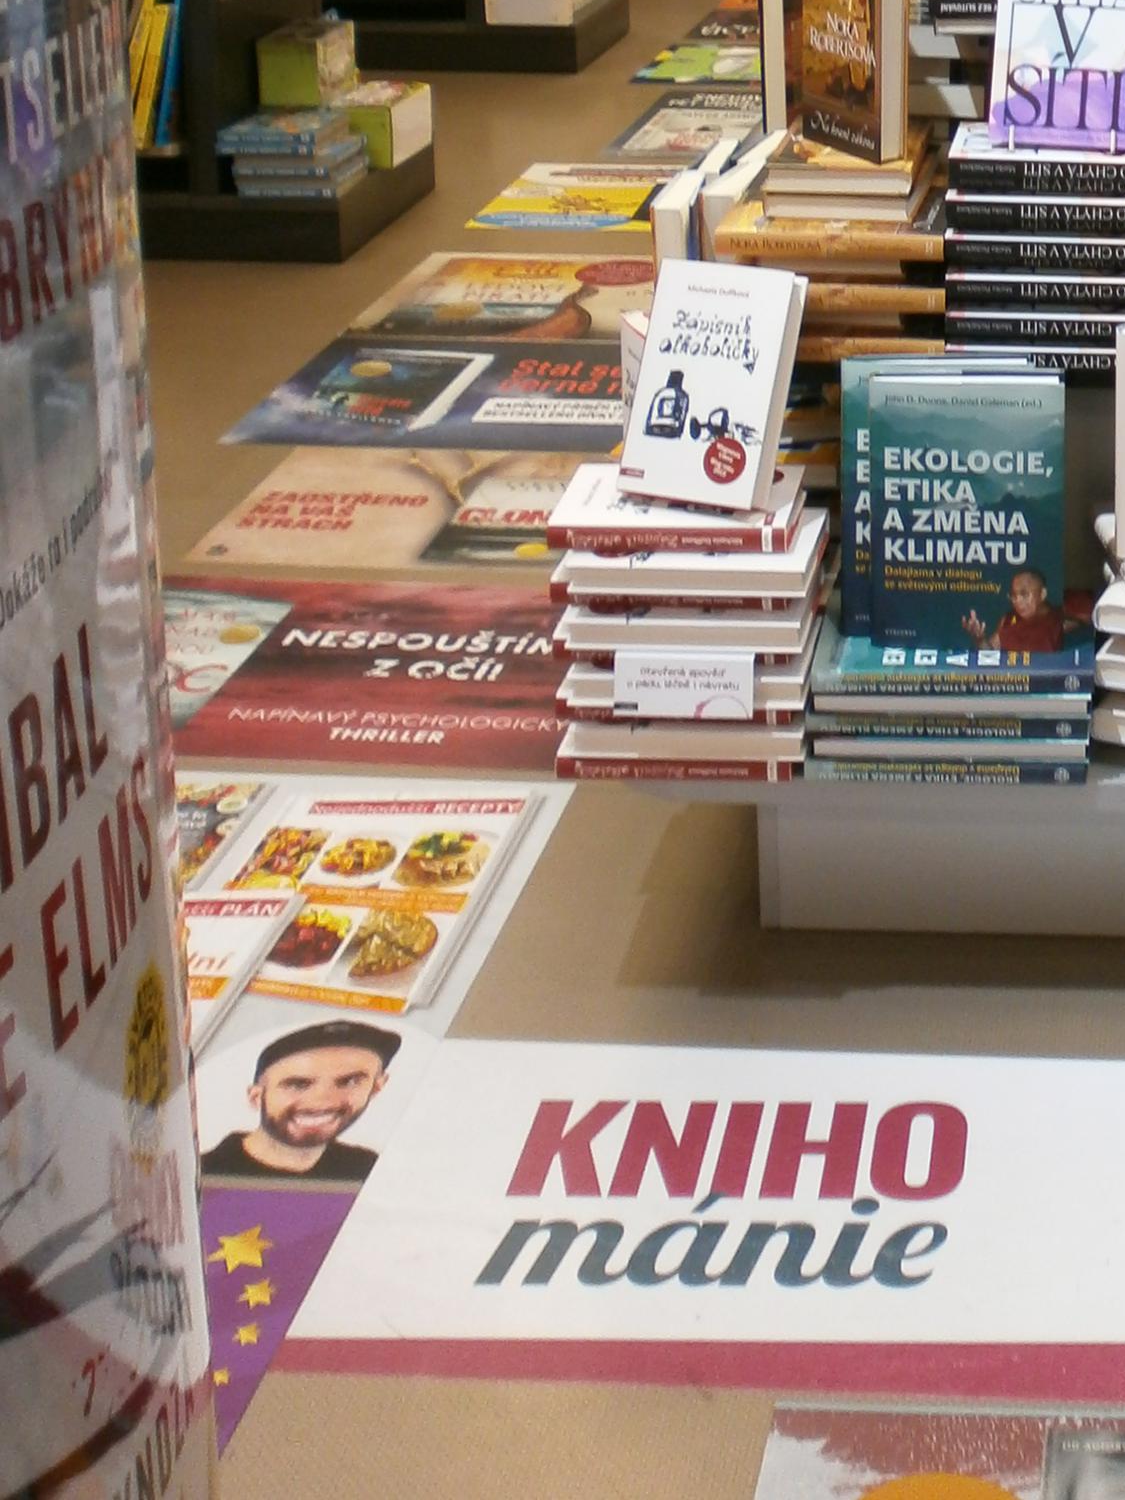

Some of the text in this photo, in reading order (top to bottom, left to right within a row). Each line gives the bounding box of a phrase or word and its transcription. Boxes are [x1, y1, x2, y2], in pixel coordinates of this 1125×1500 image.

[827, 11, 860, 41] NORA
[1054, 5, 1097, 68] V
[1054, 163, 1065, 177] V
[1068, 164, 1118, 180] CHYTÁ
[1050, 205, 1061, 219] V
[883, 446, 1054, 478] EKOLOGIE,
[883, 476, 976, 503] ETIKA
[882, 503, 1030, 535] A ZMĚNA
[883, 537, 1028, 566] KLIMATU
[885, 565, 935, 580] Dalajlama
[945, 566, 983, 581] dialogu
[363, 658, 400, 678] Z
[227, 705, 356, 726] NAPÍNAVÝ
[328, 726, 444, 745] THRILLER
[432, 801, 522, 814] RECEPTY
[505, 1099, 968, 1201] KNIHO
[474, 1192, 949, 1289] mánie
